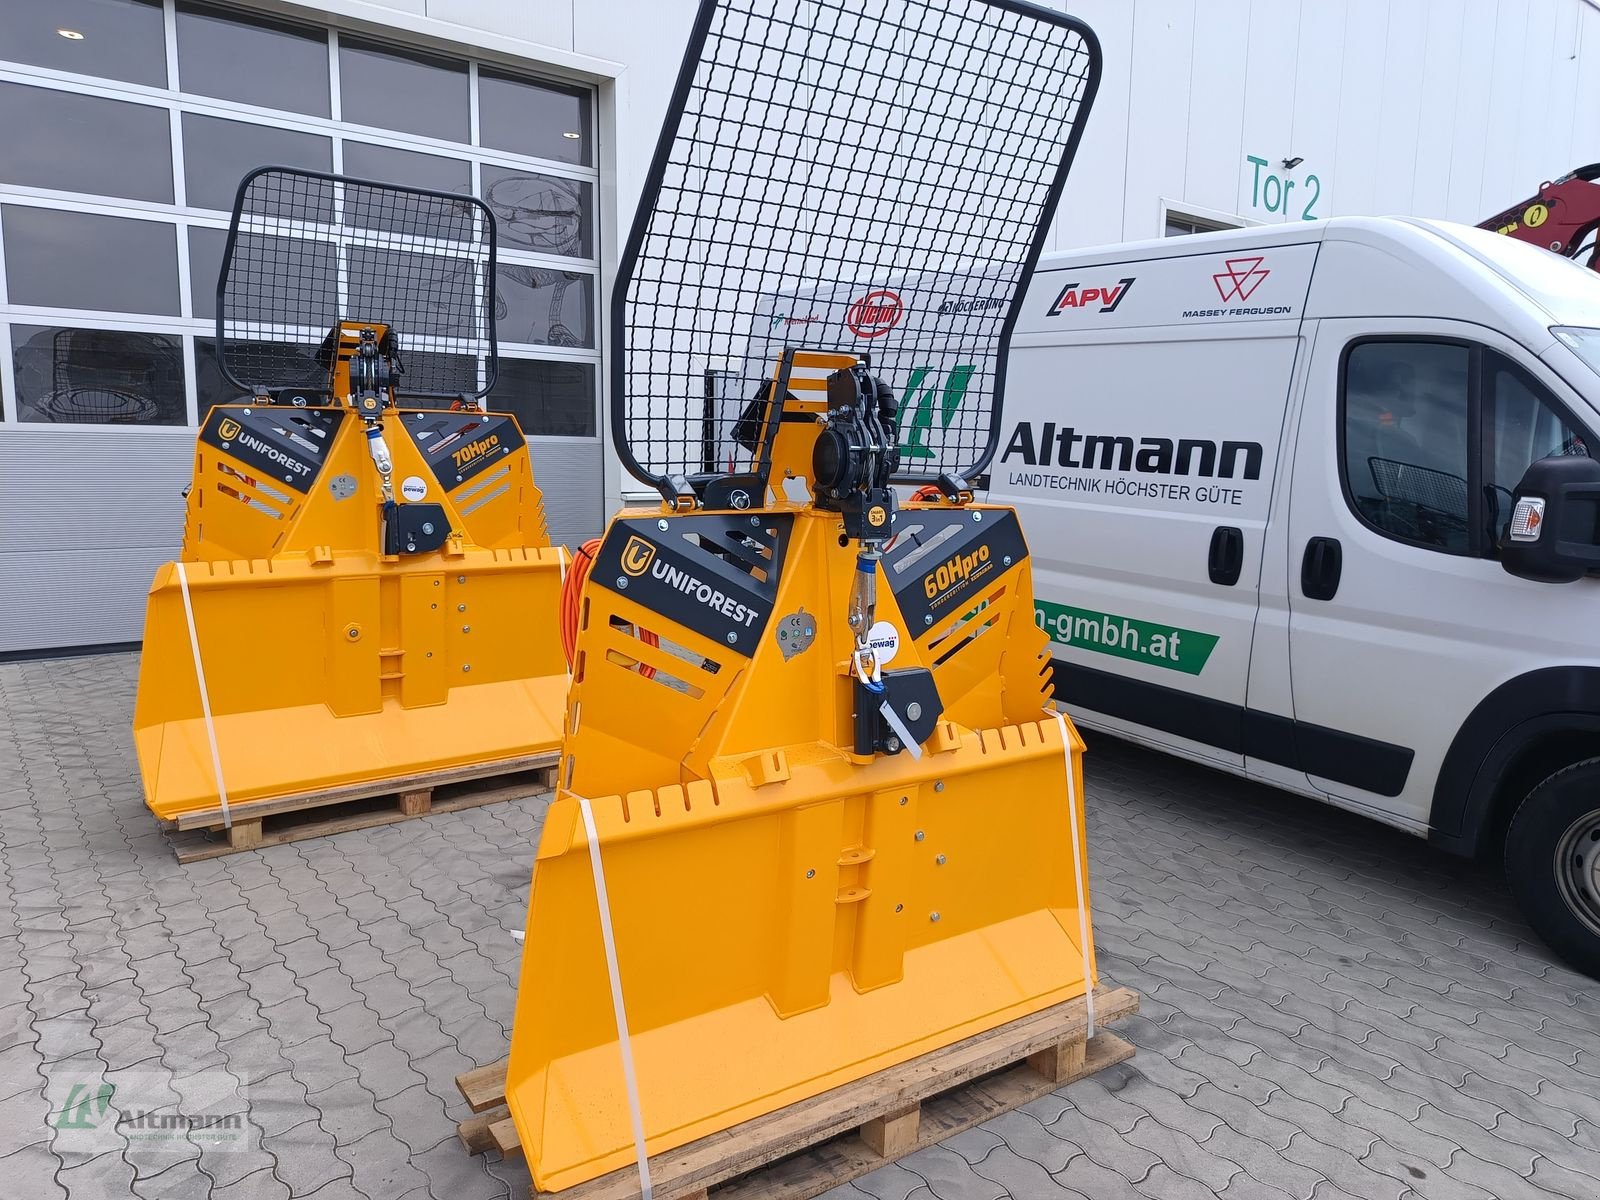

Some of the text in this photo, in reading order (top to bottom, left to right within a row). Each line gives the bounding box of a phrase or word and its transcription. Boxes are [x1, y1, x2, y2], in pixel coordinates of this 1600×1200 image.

[1247, 155, 1320, 220] Tor 2
[1059, 286, 1121, 308] APV
[1182, 306, 1292, 318] MASSEY FERGUSON
[238, 431, 312, 477] UNIFOREST
[451, 434, 499, 468] 70Hpro
[1000, 421, 1263, 480] Altmann
[1009, 472, 1243, 505] LANDTECHNIK HÖCHSTER GÜTE
[651, 558, 759, 628] UNIFOREST
[924, 544, 990, 599] 60Hpro
